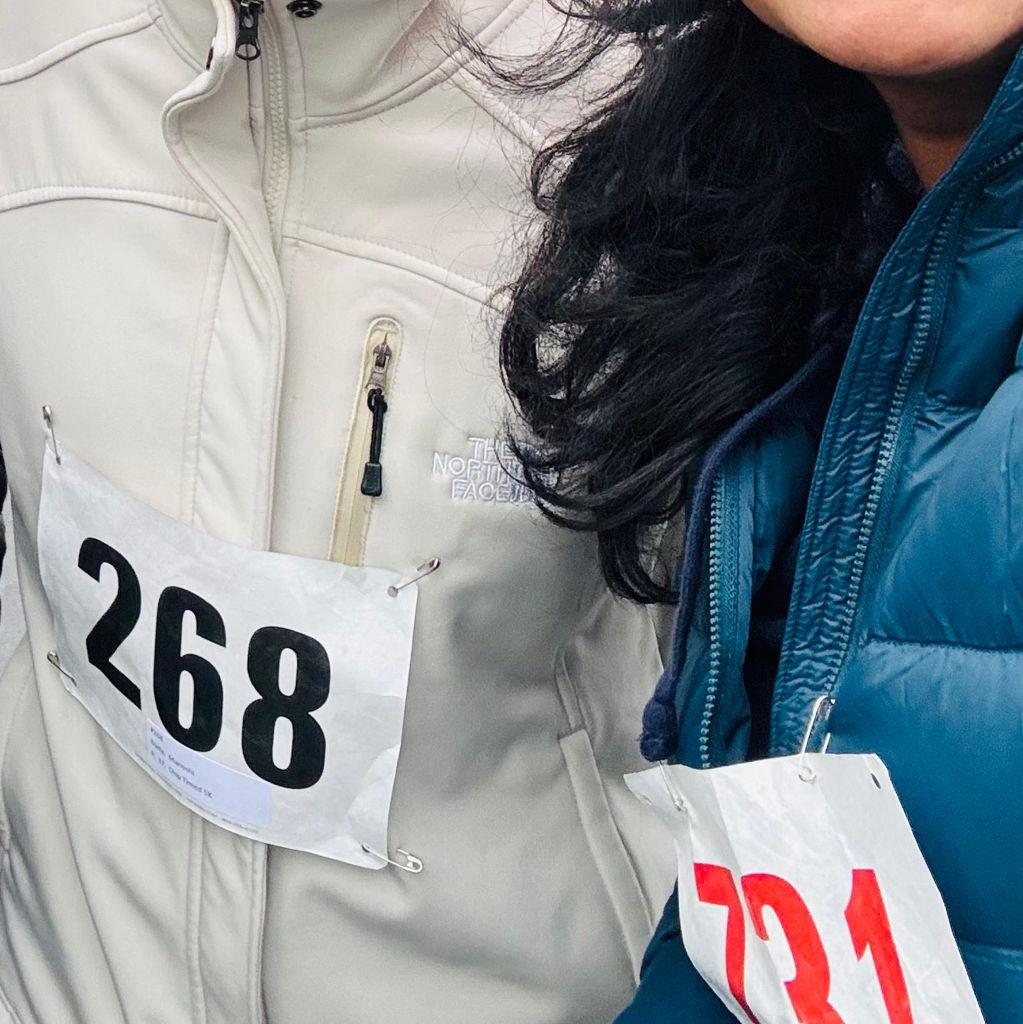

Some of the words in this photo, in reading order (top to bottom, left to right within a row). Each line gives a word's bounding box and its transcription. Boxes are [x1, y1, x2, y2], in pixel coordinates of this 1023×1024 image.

[451, 478, 512, 502] FACE
[468, 437, 514, 460] THE
[77, 537, 331, 790] 268
[693, 862, 914, 1024] 731
